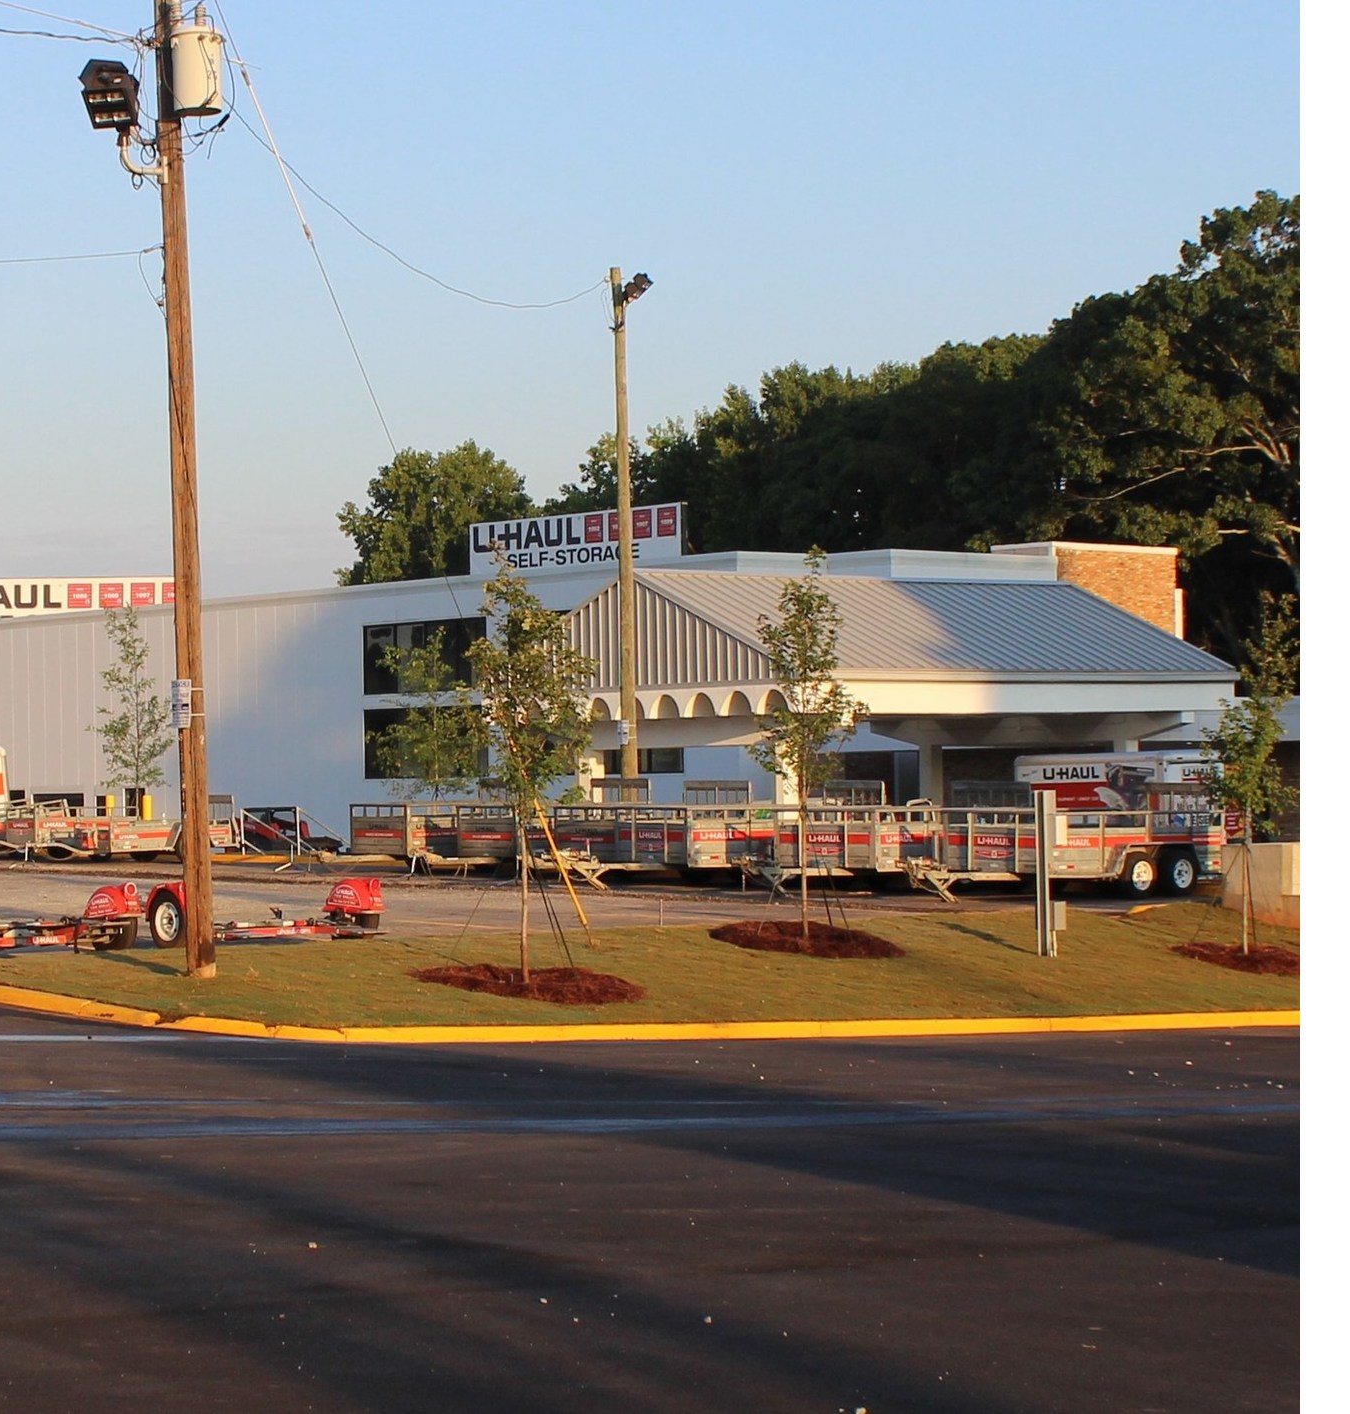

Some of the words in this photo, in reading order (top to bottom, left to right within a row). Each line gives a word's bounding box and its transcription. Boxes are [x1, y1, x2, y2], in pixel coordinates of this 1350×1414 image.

[472, 517, 581, 554] U-HAUL
[1043, 766, 1100, 780] U-HAUL
[700, 829, 734, 839] U-HAUL
[808, 834, 841, 843] U-HAUL
[977, 836, 1011, 846] U-HAUL
[1067, 838, 1092, 847] -HAUL
[33, 935, 60, 945] U-HAUL
